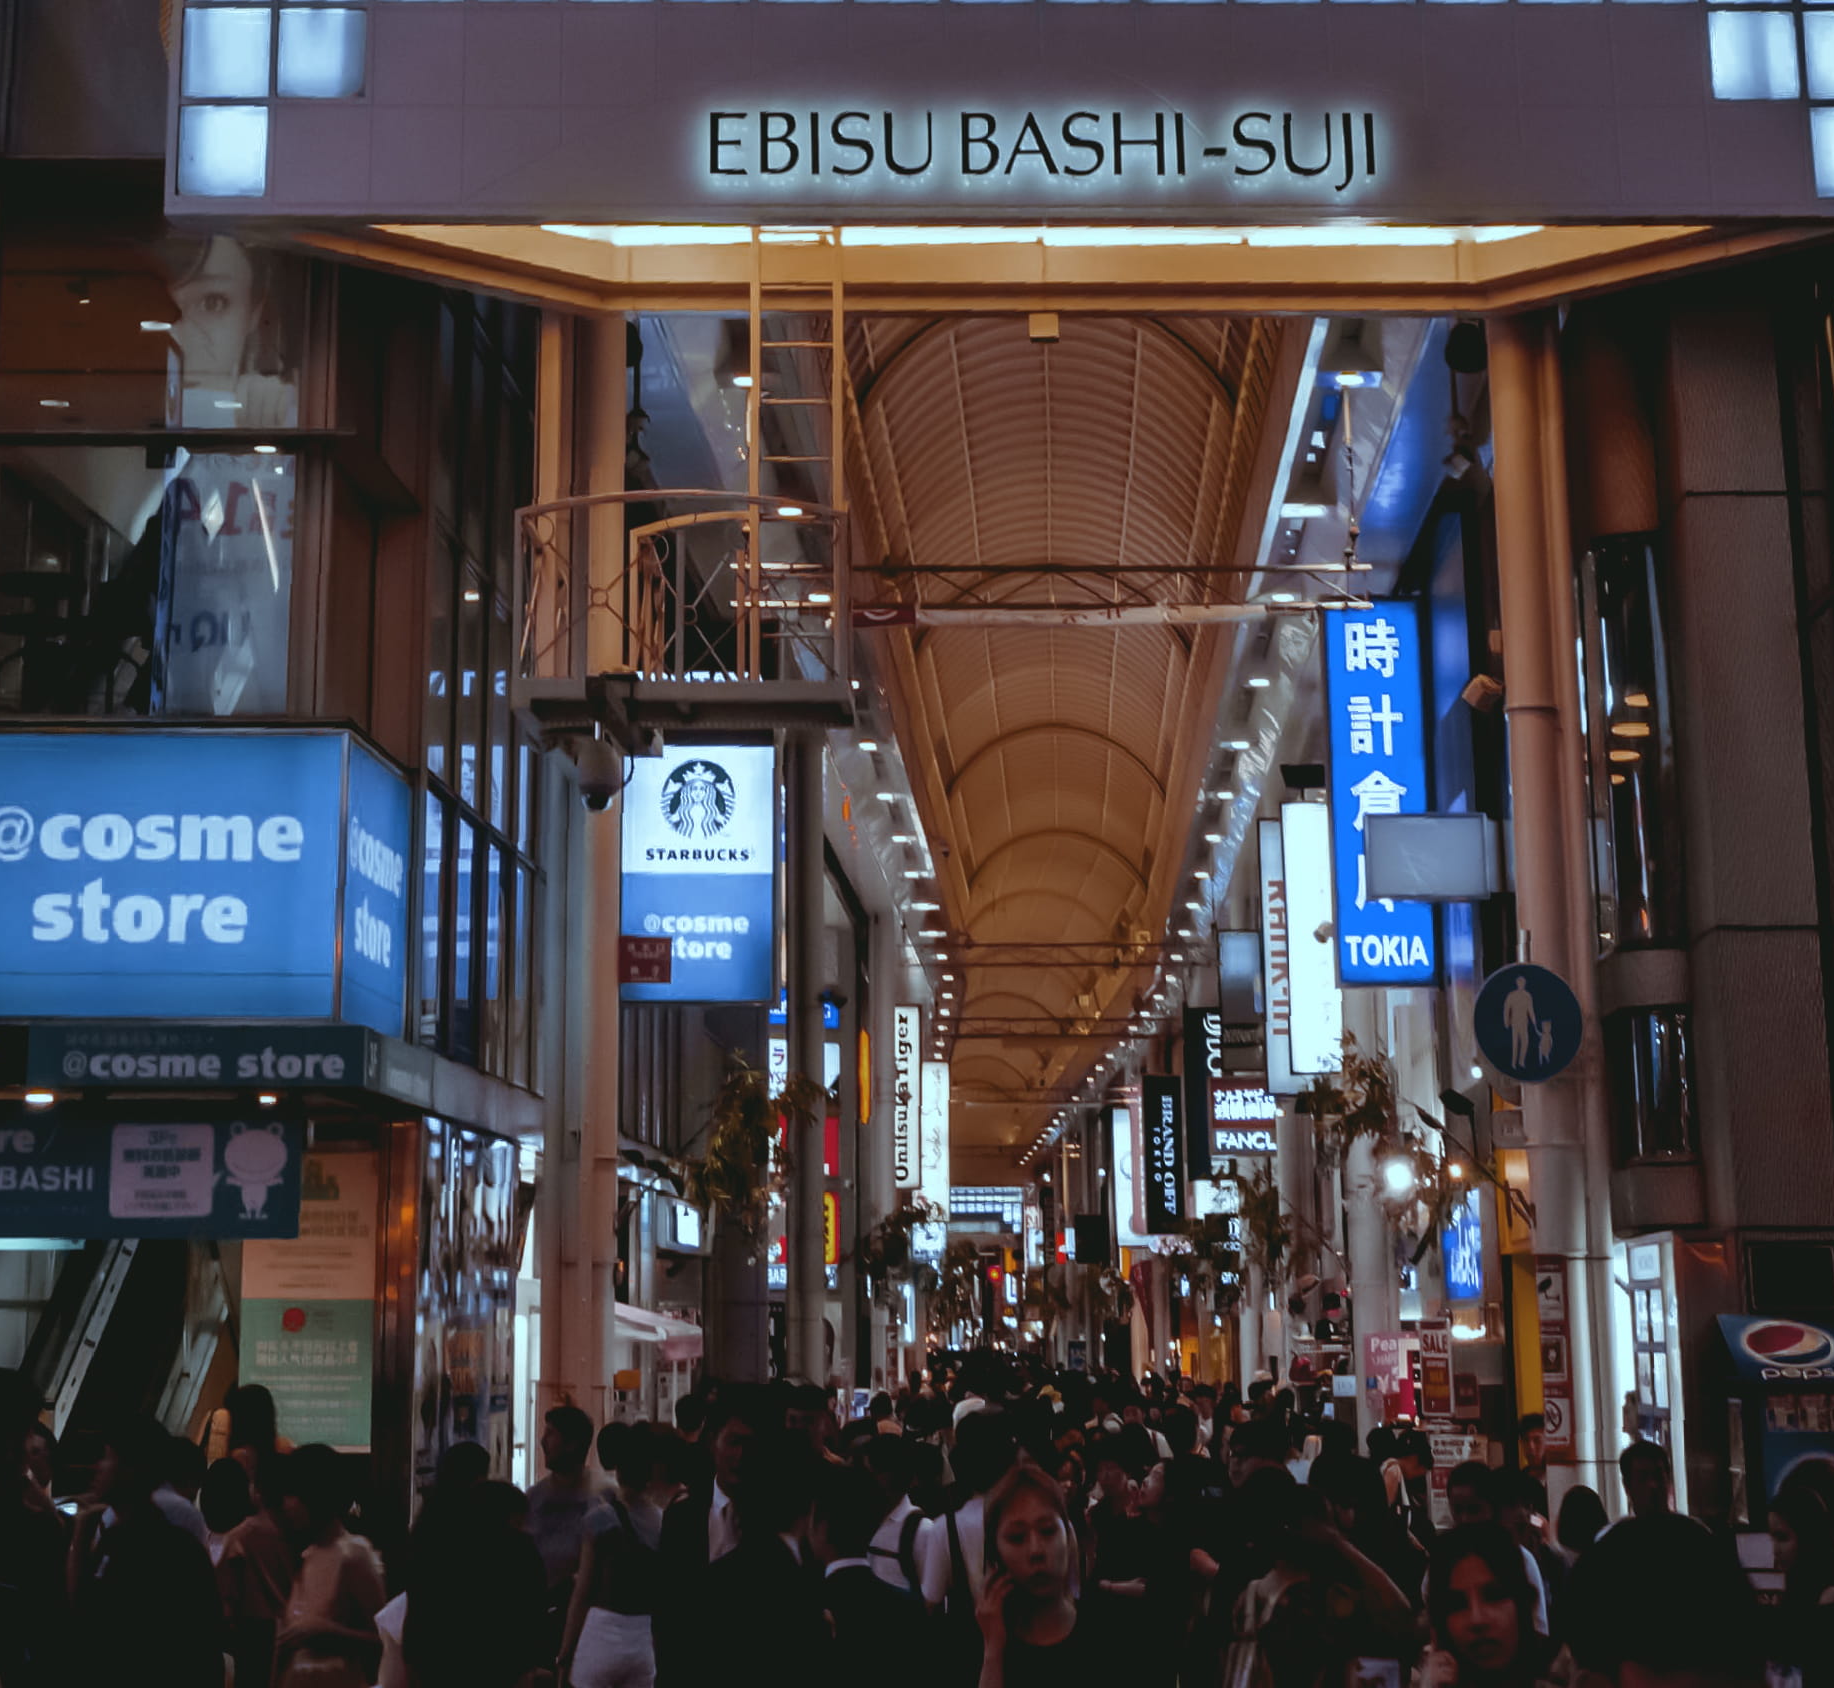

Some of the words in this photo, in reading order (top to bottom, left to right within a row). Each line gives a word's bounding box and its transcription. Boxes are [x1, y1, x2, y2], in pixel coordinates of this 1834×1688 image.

[708, 112, 932, 176] EBISU
[1343, 618, 1407, 912] 時計倉
[646, 848, 750, 861] STARBUCKS
[32, 877, 249, 944] store
[644, 913, 749, 934] @cosme
[671, 936, 733, 960] tore
[1345, 934, 1429, 968] TOKIA
[62, 1049, 222, 1080] @cosme
[237, 1045, 346, 1081] store
[1216, 1131, 1278, 1151] FANCL
[1422, 1333, 1449, 1354] SALE
